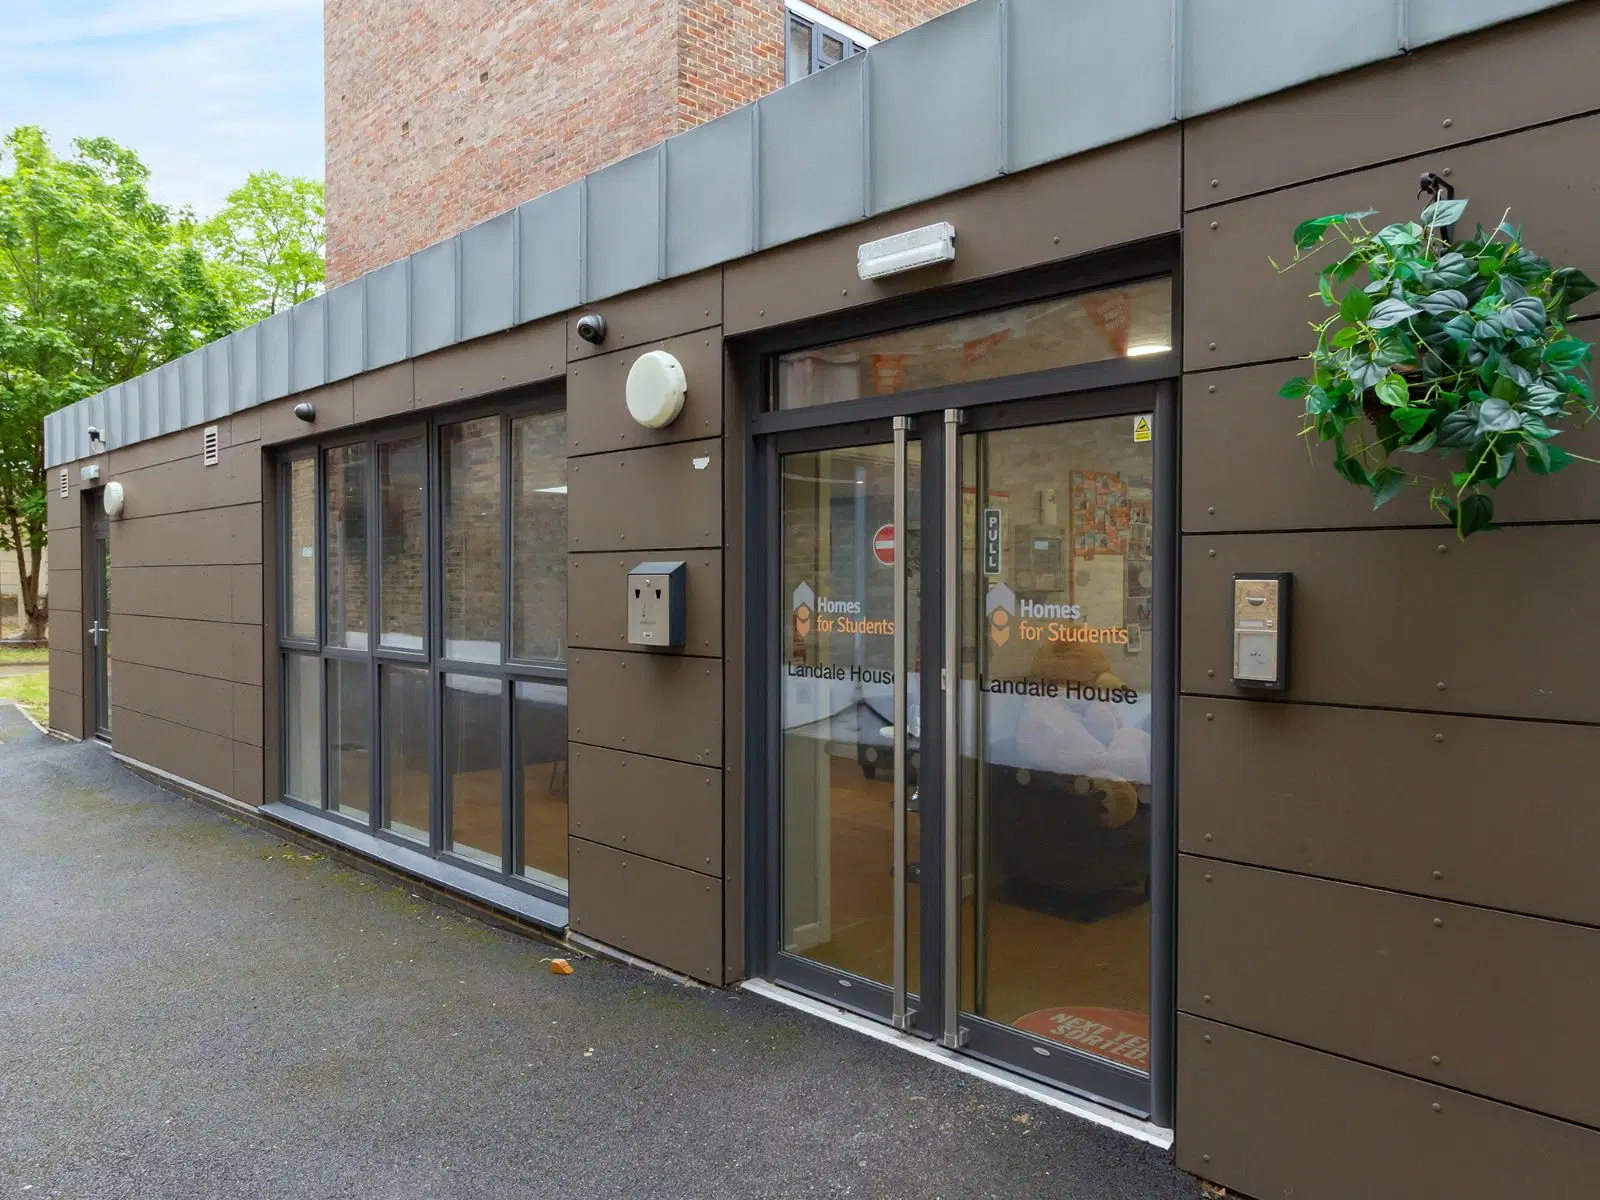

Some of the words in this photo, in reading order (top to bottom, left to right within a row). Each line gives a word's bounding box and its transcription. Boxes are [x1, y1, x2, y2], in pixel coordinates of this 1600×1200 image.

[989, 517, 998, 567] PULL
[817, 597, 861, 614] Homes
[1020, 599, 1080, 619] Homes
[816, 615, 834, 632] for
[837, 616, 896, 635] Students
[1019, 620, 1043, 641] for
[1047, 622, 1128, 645] Students
[787, 660, 845, 681] Landale
[979, 673, 1058, 698] Landale
[1066, 680, 1138, 705] House
[1050, 1013, 1112, 1036] NEXT
